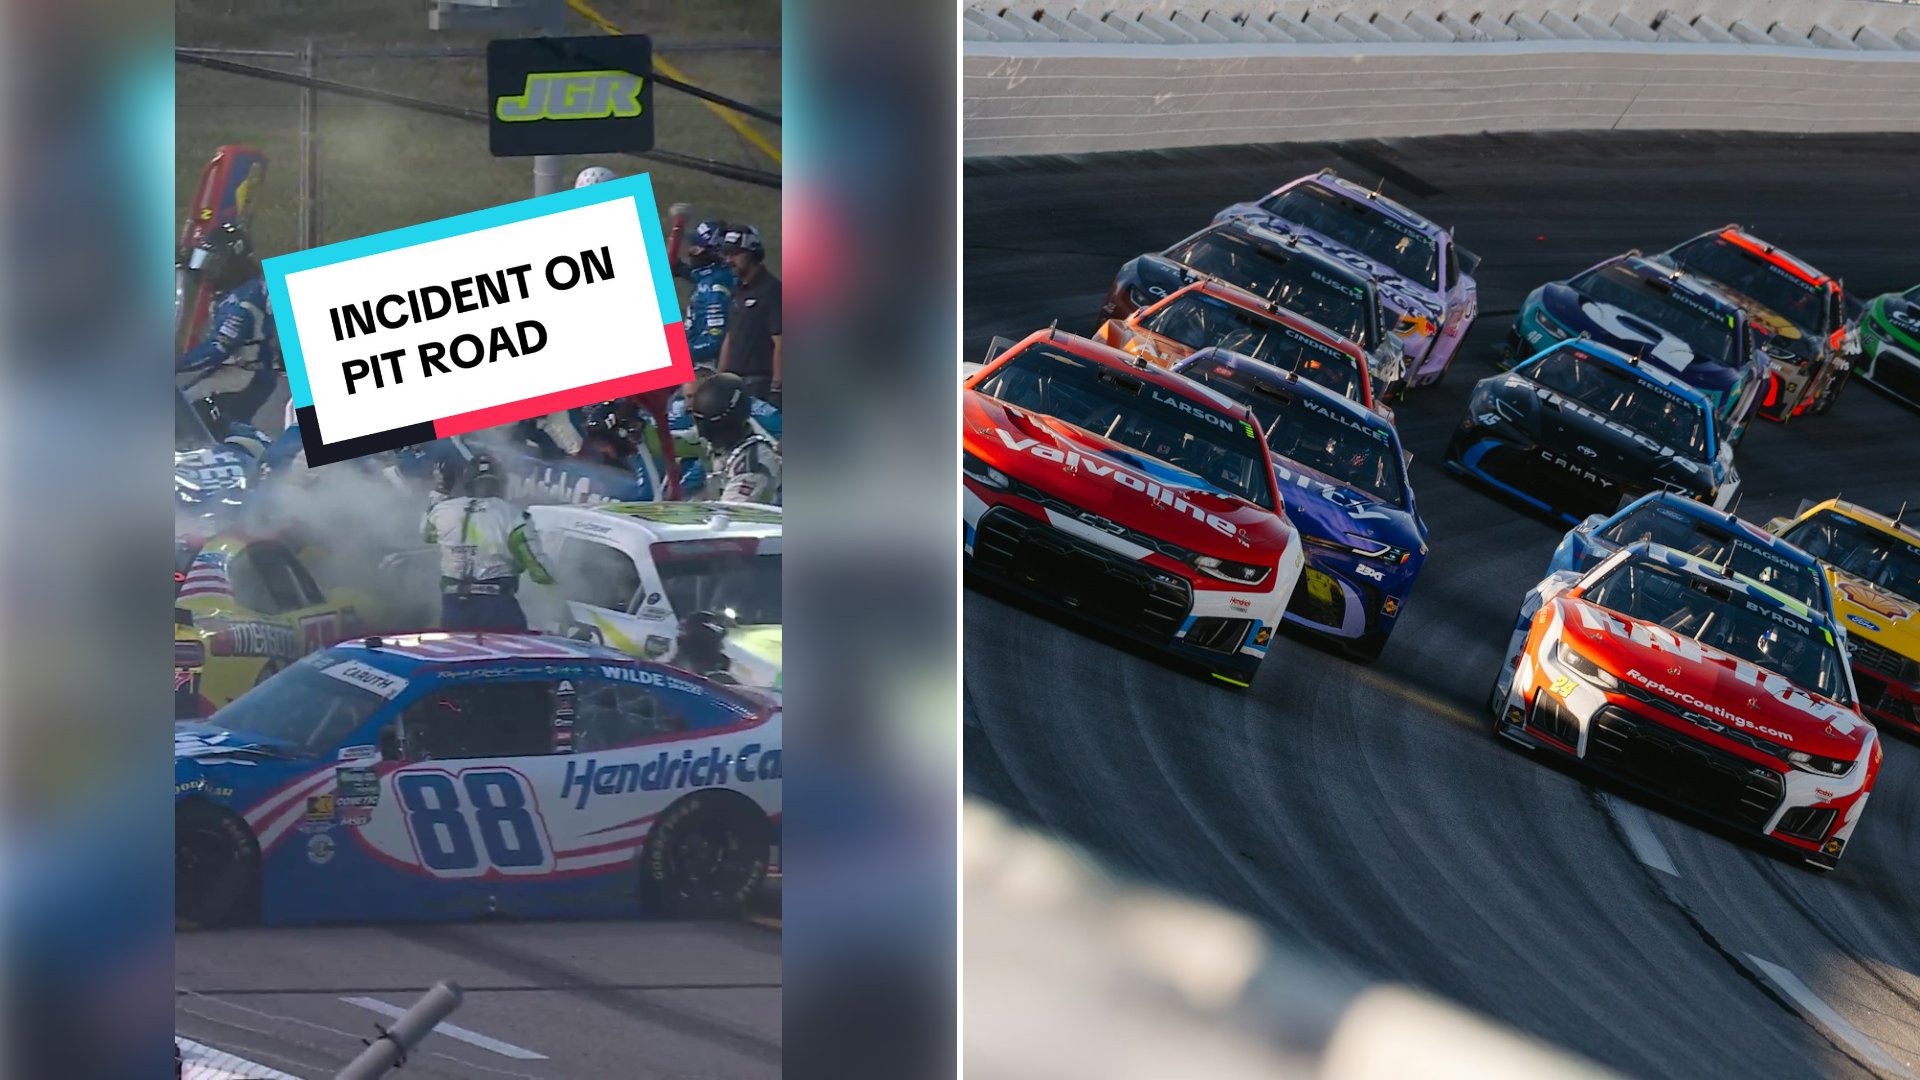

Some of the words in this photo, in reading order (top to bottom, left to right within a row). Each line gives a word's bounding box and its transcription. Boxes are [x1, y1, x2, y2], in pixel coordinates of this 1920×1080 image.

[497, 71, 643, 122] JGR
[1311, 270, 1363, 300] BUSCH
[1769, 264, 1817, 294] BRISCOE
[1672, 292, 1725, 323] BOWMAN
[1285, 329, 1342, 361] CINDRIC
[1637, 378, 1692, 410] REDDICK
[1151, 391, 1234, 433] LARSON
[1303, 399, 1382, 442] WALLACE
[1478, 411, 1501, 426] 45
[995, 428, 1237, 538] Valvoline
[1540, 450, 1613, 488] CAMRY
[1733, 539, 1799, 573] GRAGSON
[1746, 601, 1810, 636] BYRON
[342, 667, 394, 689] CARUTH
[600, 665, 665, 687] WILDE
[1549, 675, 1579, 698] 24
[1626, 669, 1794, 742] RaptorCoatings.com
[560, 746, 728, 810] Hendrick
[398, 772, 545, 870] 88
